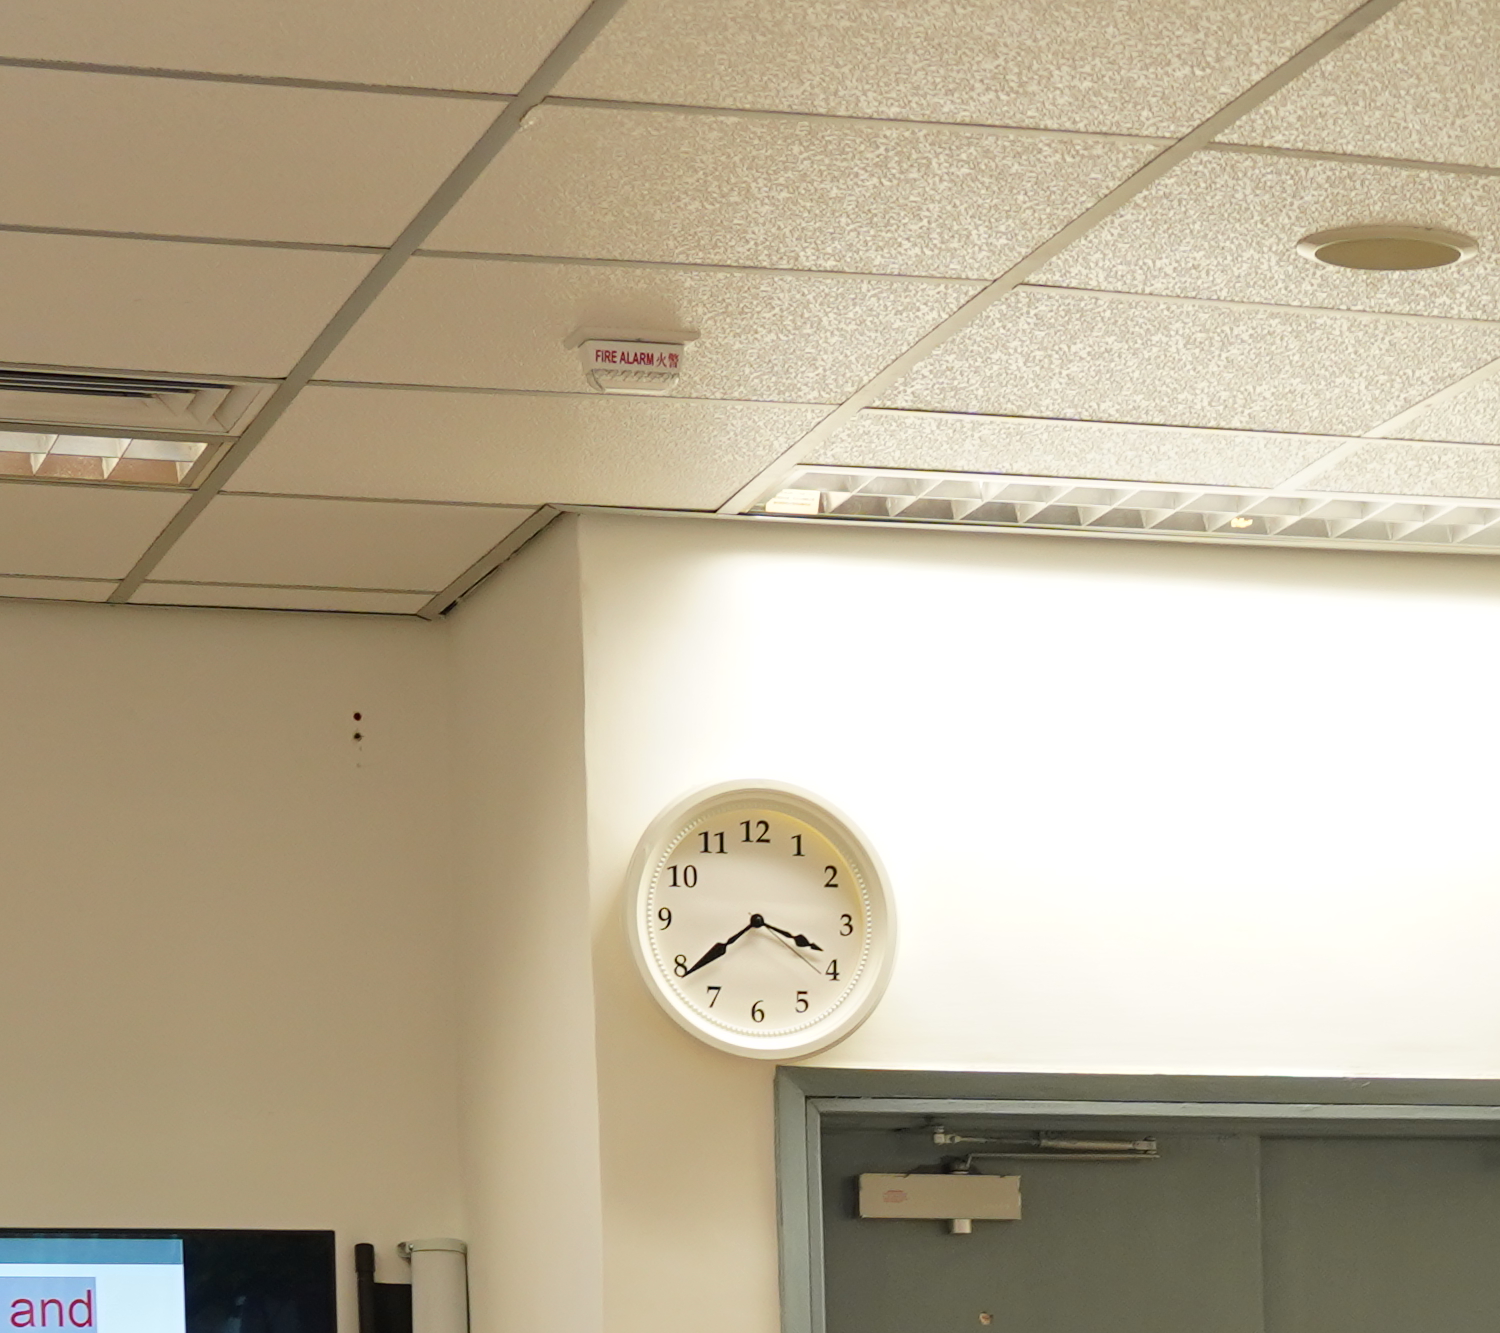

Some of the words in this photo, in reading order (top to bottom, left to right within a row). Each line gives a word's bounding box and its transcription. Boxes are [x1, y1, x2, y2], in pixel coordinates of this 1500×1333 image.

[595, 350, 617, 363] FIRE
[620, 352, 654, 366] ALARM
[656, 352, 679, 368] 火警
[698, 831, 728, 854] 11
[740, 820, 770, 843] 12
[791, 834, 806, 857] 1
[667, 865, 698, 888] 10
[824, 865, 839, 888] 2
[658, 907, 672, 930] 9
[839, 914, 853, 936] 3
[674, 955, 688, 978] 8
[825, 959, 840, 981] 4
[706, 986, 721, 1008] 7
[795, 991, 809, 1013] 5
[751, 1000, 765, 1023] 6
[10, 1289, 94, 1328] and
